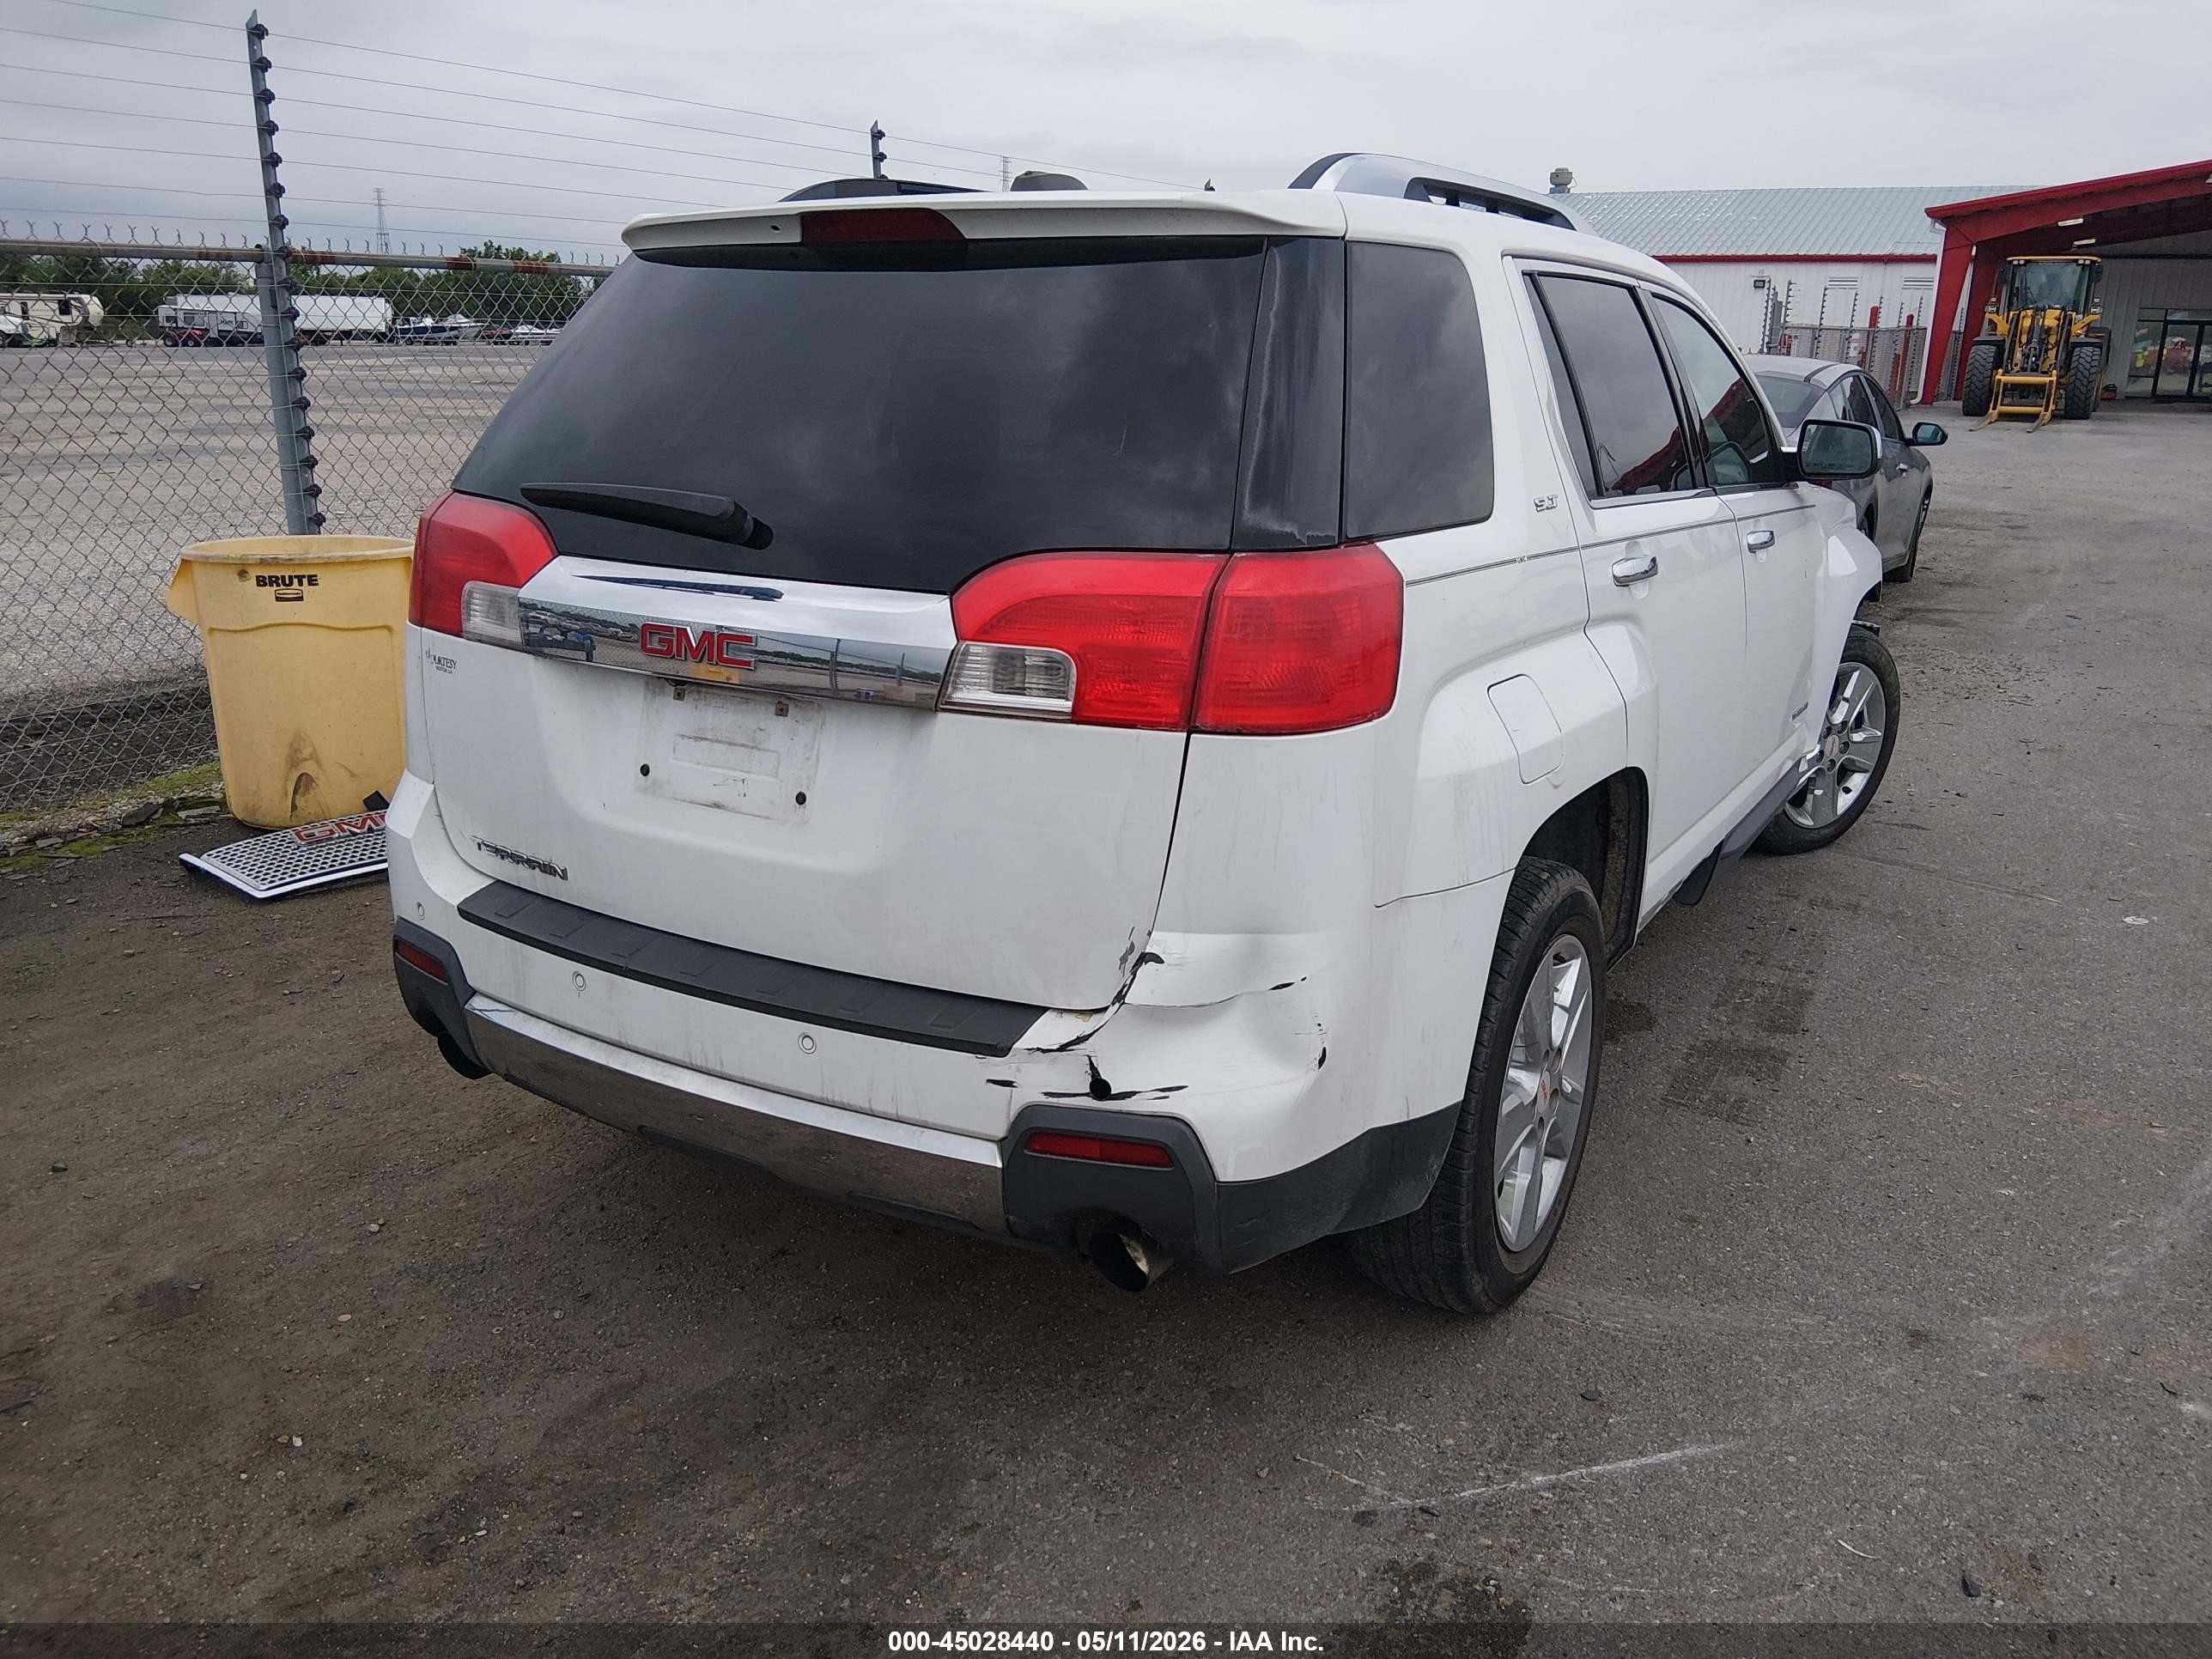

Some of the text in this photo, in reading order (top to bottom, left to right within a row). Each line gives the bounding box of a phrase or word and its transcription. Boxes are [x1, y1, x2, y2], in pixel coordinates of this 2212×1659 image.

[255, 574, 319, 587] BRUTE
[641, 622, 757, 670] GMC
[294, 814, 386, 845] GM
[471, 835, 568, 881] TERRAIN
